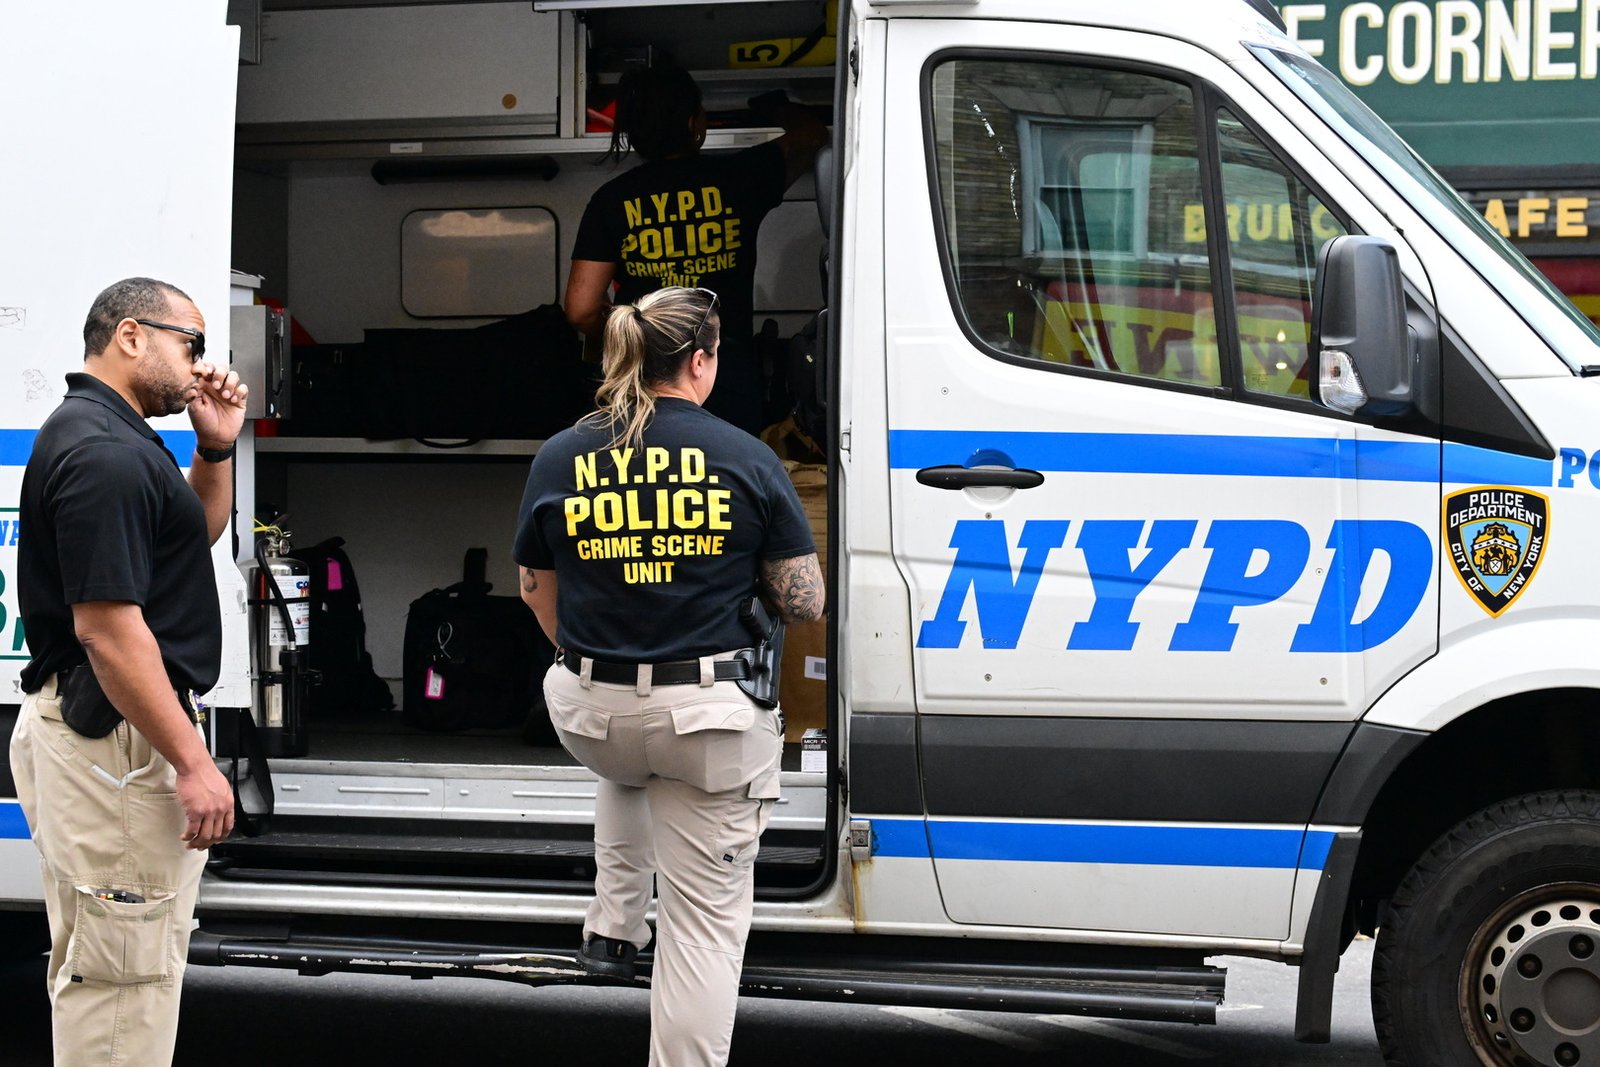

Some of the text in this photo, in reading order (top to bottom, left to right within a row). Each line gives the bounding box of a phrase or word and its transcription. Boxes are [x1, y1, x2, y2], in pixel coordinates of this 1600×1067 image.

[623, 186, 733, 229] N.Y.P.D.
[1484, 197, 1588, 238] AFE
[621, 218, 742, 259] POLICE
[626, 252, 737, 279] CRIME SCENE
[661, 274, 700, 288] UNIT
[575, 447, 719, 491] N.Y.P.D.
[564, 488, 733, 536] POLICE
[1450, 504, 1543, 528] DEPARTMENT
[1469, 492, 1525, 508] POLICE
[577, 534, 725, 560] CRIME SCENE
[1451, 535, 1543, 600] CITY OF NEW YORK
[624, 561, 675, 584] UNIT
[915, 520, 1434, 653] NYPD
